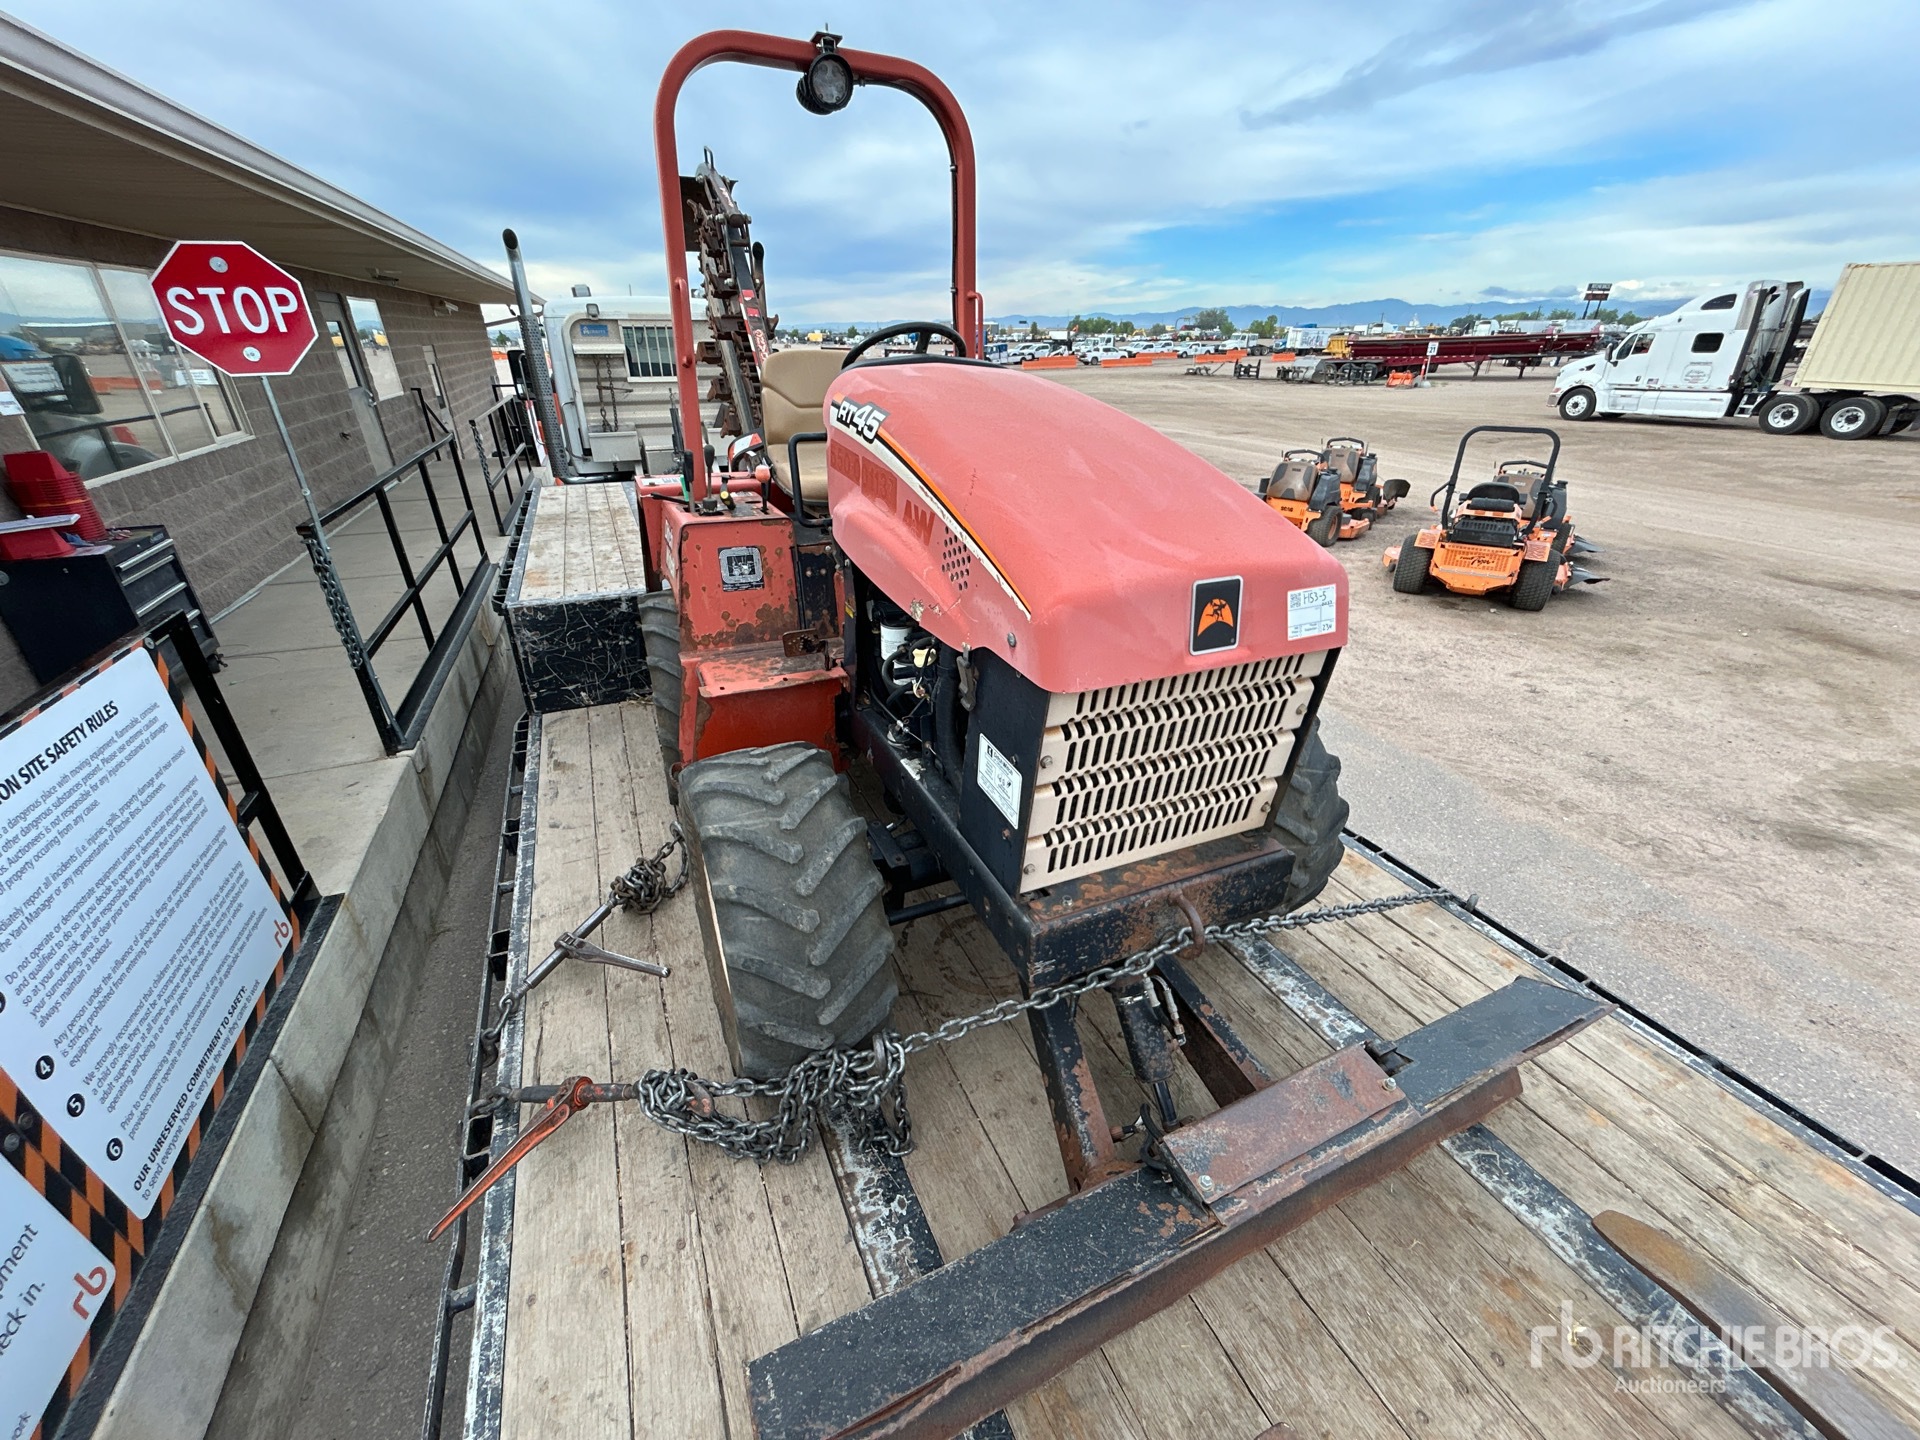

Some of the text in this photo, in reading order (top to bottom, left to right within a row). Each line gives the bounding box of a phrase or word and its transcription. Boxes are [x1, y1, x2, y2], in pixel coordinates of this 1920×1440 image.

[166, 286, 298, 335] STOP
[18, 754, 48, 784] SITE
[45, 724, 86, 763] SAFETY
[86, 701, 118, 732] RULES
[2, 781, 83, 852] other dangerous substances
[7, 828, 45, 867] Auctioneers
[42, 826, 52, 834] is
[50, 815, 62, 828] not
[61, 790, 92, 819] responsible
[8, 799, 42, 829] dangerous
[40, 786, 58, 804] place
[56, 774, 71, 788] with
[5, 859, 34, 890] property
[33, 836, 61, 862] occuring
[57, 823, 74, 838] from
[73, 813, 84, 826] any
[9, 920, 28, 939] Yard
[24, 894, 54, 924] Manager
[54, 886, 62, 896] or
[62, 875, 74, 889] any
[73, 839, 109, 877] representative
[23, 886, 44, 909] report
[43, 876, 53, 890] all
[50, 854, 77, 881] incidents
[5, 858, 122, 985] Do not operate or demonstrate equipment
[15, 976, 30, 996] and
[28, 946, 57, 980] qualified
[55, 940, 64, 950] to
[63, 931, 72, 942] do
[78, 912, 86, 923] If
[84, 903, 96, 919] you
[95, 885, 113, 905] decide
[22, 995, 32, 1006] so
[31, 985, 41, 996] at
[39, 968, 54, 990] your
[54, 953, 69, 970] own
[80, 924, 92, 941] and
[91, 916, 101, 928] are
[100, 885, 128, 917] responsible
[30, 906, 123, 1019] your surrounding area is clear prior
[274, 920, 290, 948] rb
[38, 1000, 61, 1027] always
[60, 969, 87, 1001] maintain
[54, 935, 140, 1048] Any person under the influence of
[60, 947, 147, 1058] is strictly prohibited from entering
[39, 1060, 51, 1074] 4
[83, 987, 154, 1085] We strongly recommend that
[97, 1066, 111, 1088] child
[128, 1025, 141, 1042] they
[138, 1008, 152, 1026] must
[149, 999, 158, 1009] be
[100, 1082, 115, 1104] adult
[114, 1042, 142, 1083] supervision
[140, 1033, 148, 1043] at
[107, 1003, 178, 1113] operating and being in or on any
[69, 1098, 82, 1112] 5
[120, 1028, 184, 1130] Prior to commencing with the
[129, 1032, 192, 1140] providers must operate in strict
[134, 1164, 151, 1190] OUR
[149, 1093, 187, 1162] UNRESERVED
[187, 1028, 222, 1092] COMMITMENT
[220, 1016, 229, 1029] TO
[142, 1189, 151, 1200] to
[149, 1163, 163, 1188] send
[161, 1125, 183, 1164] everyone
[195, 1078, 208, 1100] every
[213, 1050, 222, 1063] the
[220, 1035, 231, 1050] way
[228, 1020, 239, 1036] they
[110, 1142, 120, 1156] 6
[18, 1283, 46, 1306] in.
[72, 1266, 107, 1320] rb
